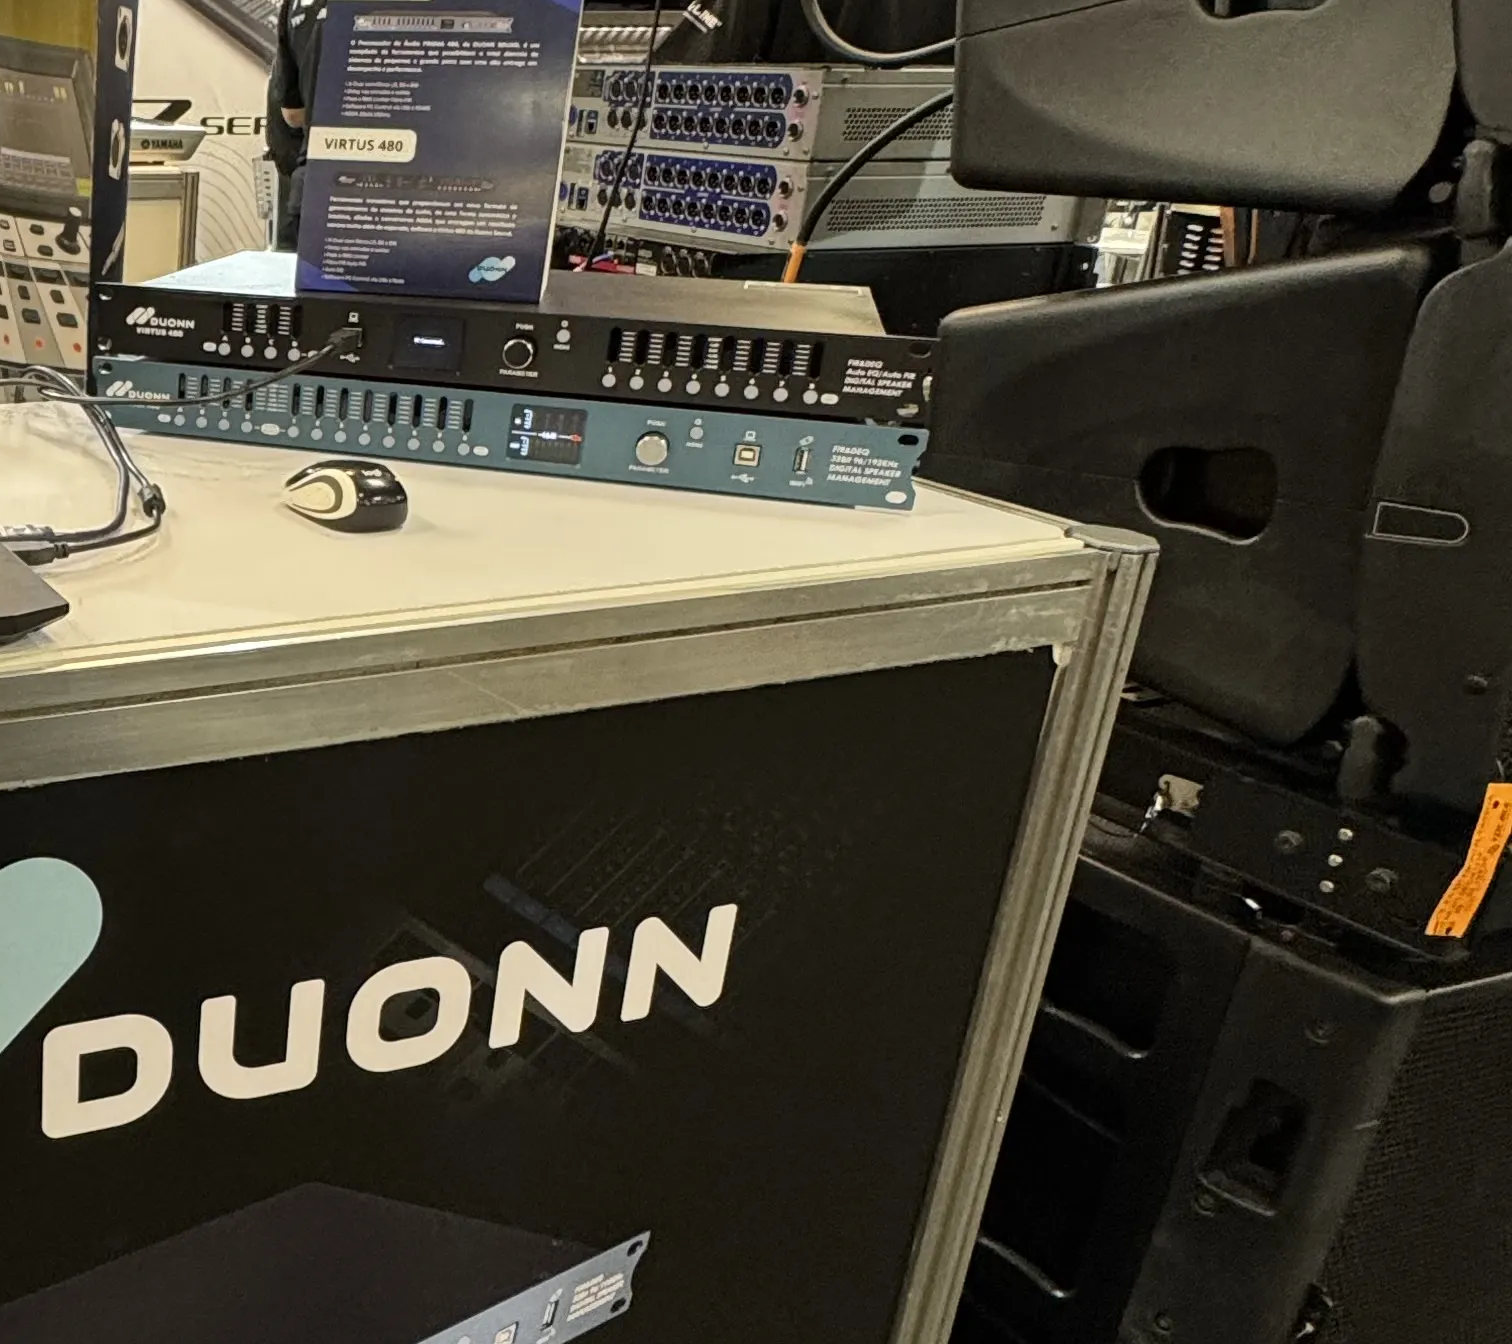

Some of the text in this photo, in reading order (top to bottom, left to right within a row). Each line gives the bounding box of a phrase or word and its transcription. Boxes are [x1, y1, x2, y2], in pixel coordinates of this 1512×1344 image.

[151, 138, 184, 150] YAMAHA
[324, 138, 404, 153] VIRTUS 480
[150, 318, 196, 329] DUONN
[846, 368, 866, 377] Auto
[844, 376, 913, 389] DIGITAL SPEAKER
[128, 391, 170, 401] DUONN
[842, 386, 904, 397] MANAGEMENT
[829, 464, 902, 478] DIGITAL SPEAKER
[826, 474, 892, 486] MANAGEMENT
[42, 903, 737, 1139] DUONN
